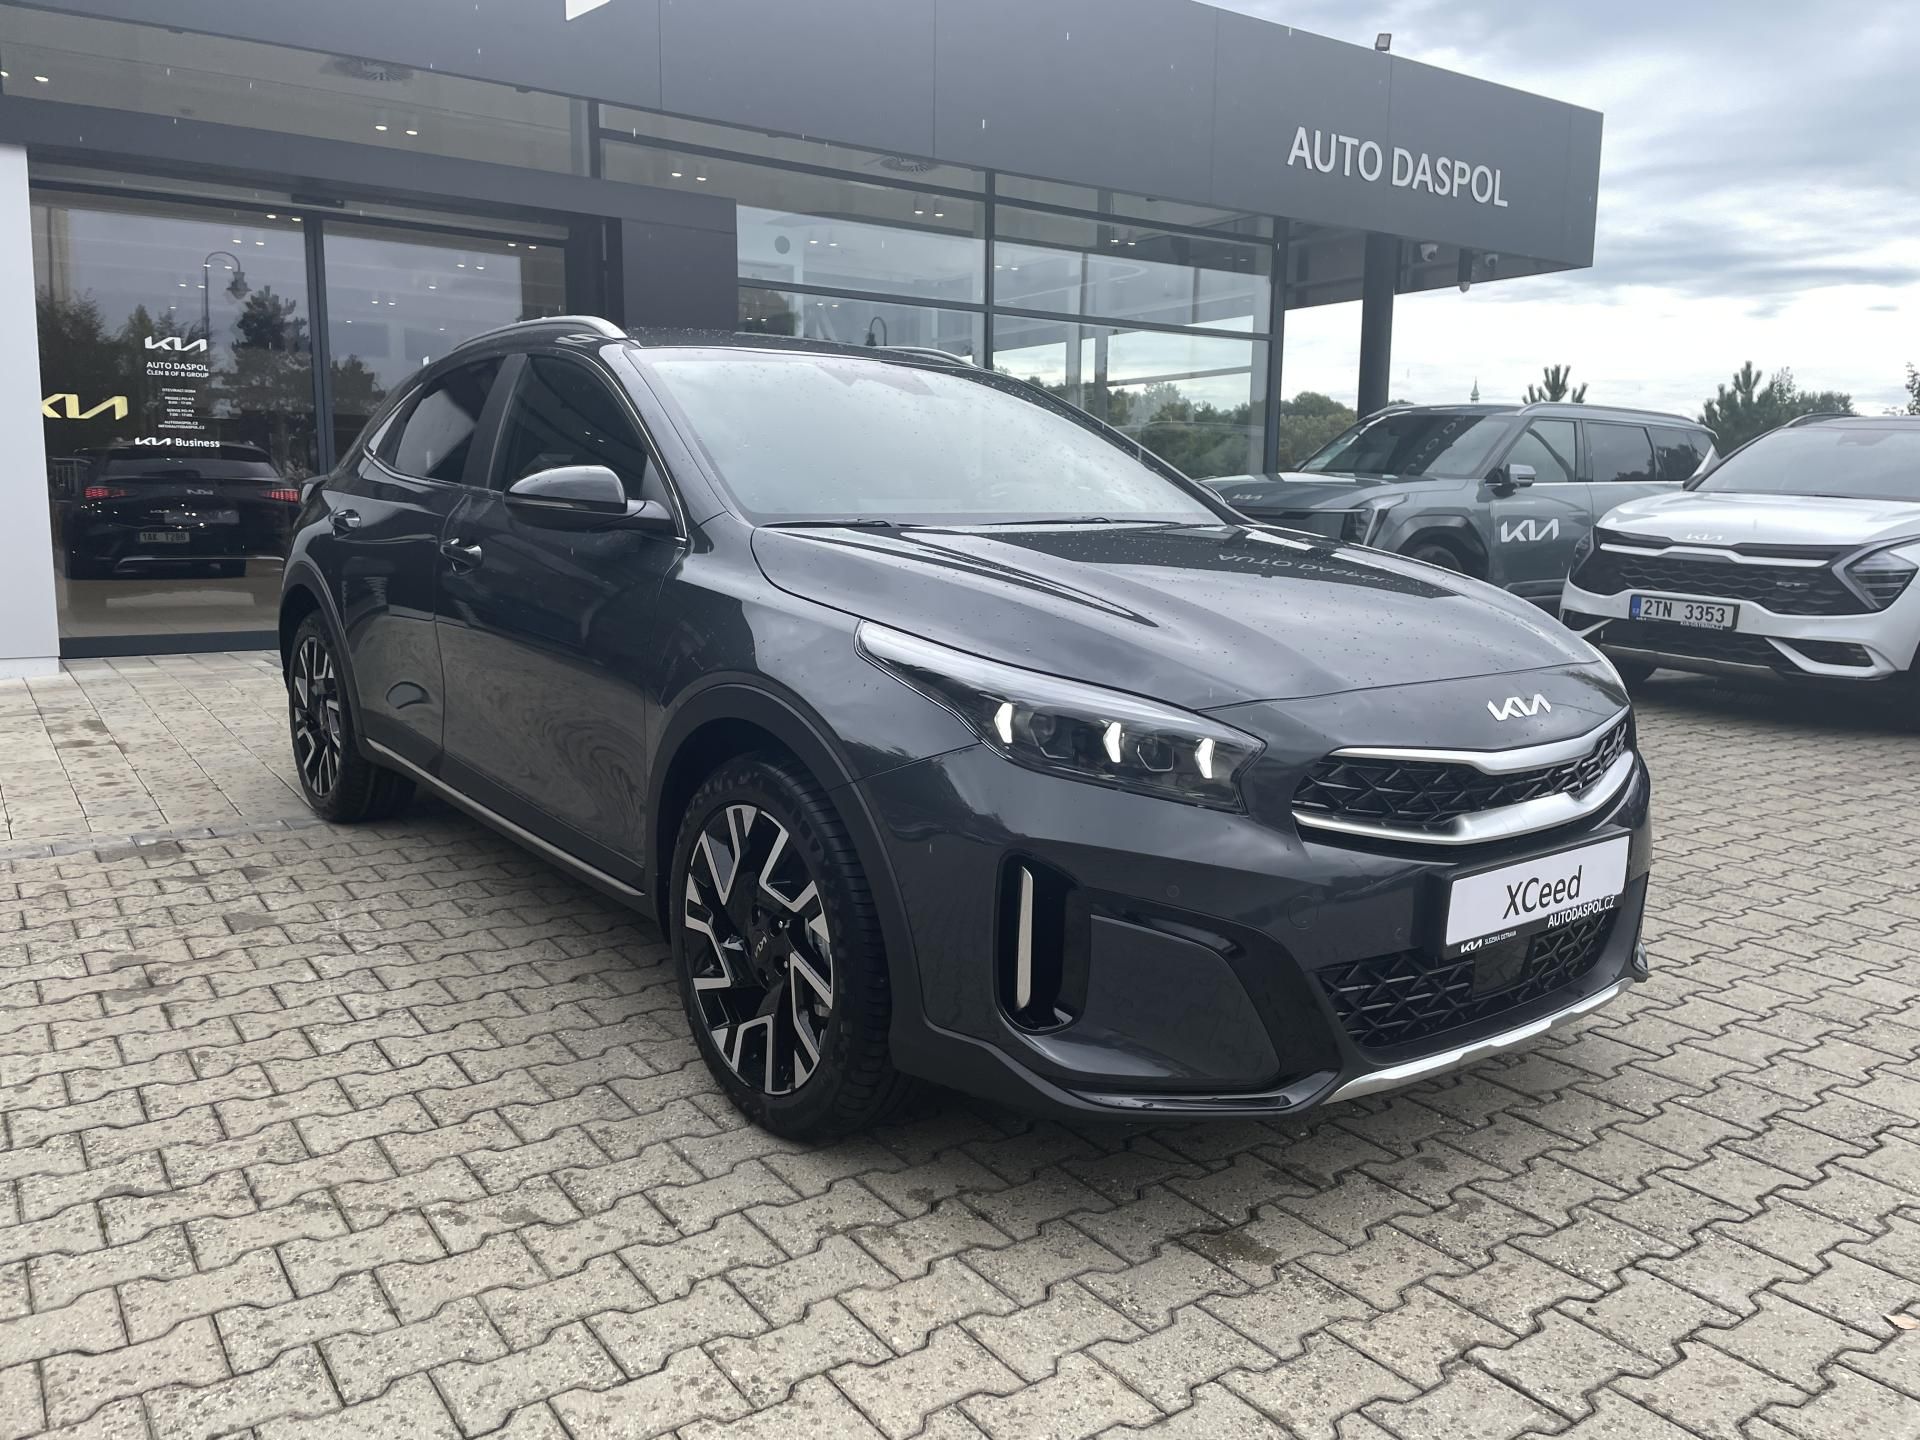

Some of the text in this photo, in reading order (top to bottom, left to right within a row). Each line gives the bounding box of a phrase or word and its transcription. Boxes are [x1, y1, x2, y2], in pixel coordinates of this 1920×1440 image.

[1286, 126, 1509, 207] AUTO DASPOL
[144, 335, 207, 352] KIA
[146, 361, 208, 372] AUTO DASPOL
[135, 436, 220, 448] KIA Business
[1500, 518, 1560, 543] KIA
[1643, 599, 1725, 624] 2TN 3353
[1487, 693, 1552, 721] KIA
[1502, 865, 1583, 920] XCeed
[1547, 896, 1616, 929] AUTODASPOL.CZ
[1460, 939, 1483, 954] KIA
